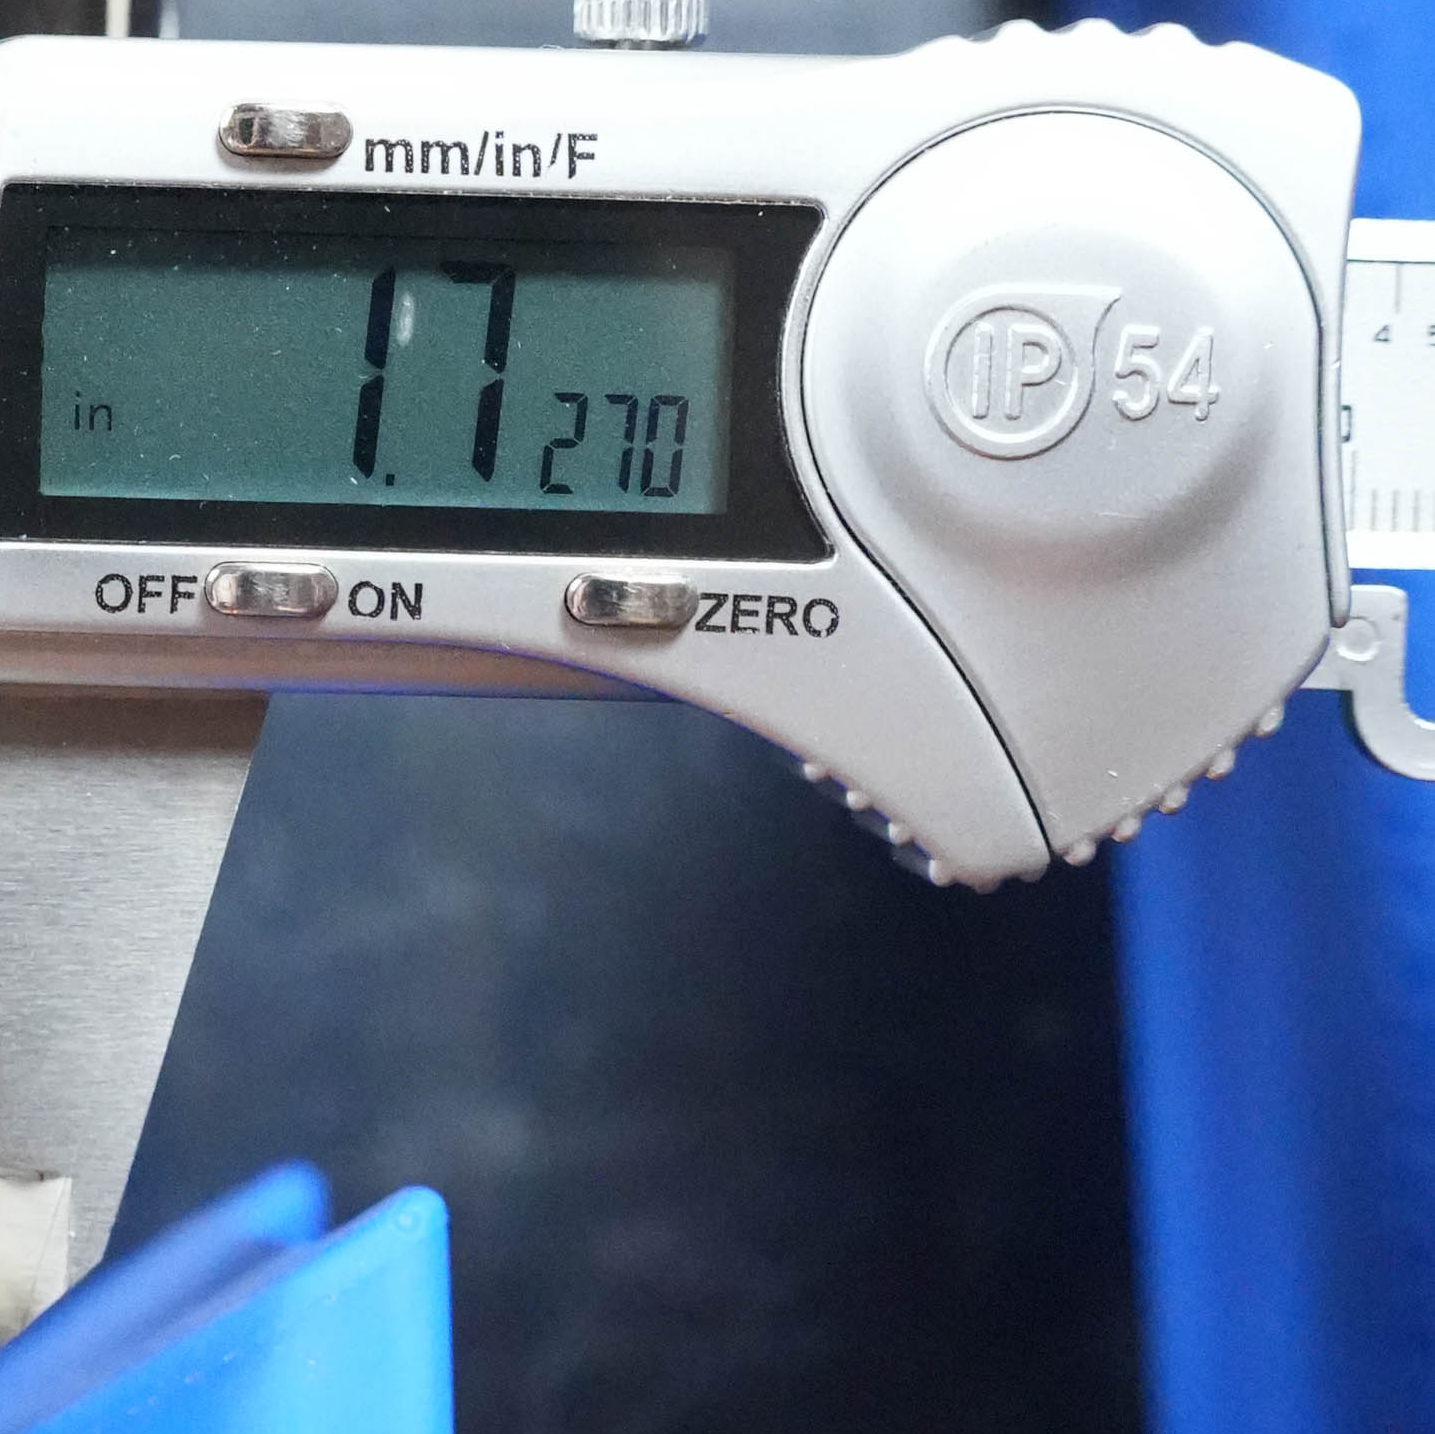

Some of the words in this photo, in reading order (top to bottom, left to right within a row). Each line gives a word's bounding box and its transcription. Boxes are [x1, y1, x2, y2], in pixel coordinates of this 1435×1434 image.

[364, 129, 599, 180] mm/in/F
[971, 321, 1064, 421] IP
[1112, 323, 1220, 423] 54
[72, 392, 114, 433] in
[94, 572, 200, 615] OFF
[347, 579, 424, 622] ON
[694, 588, 841, 640] ZERO
